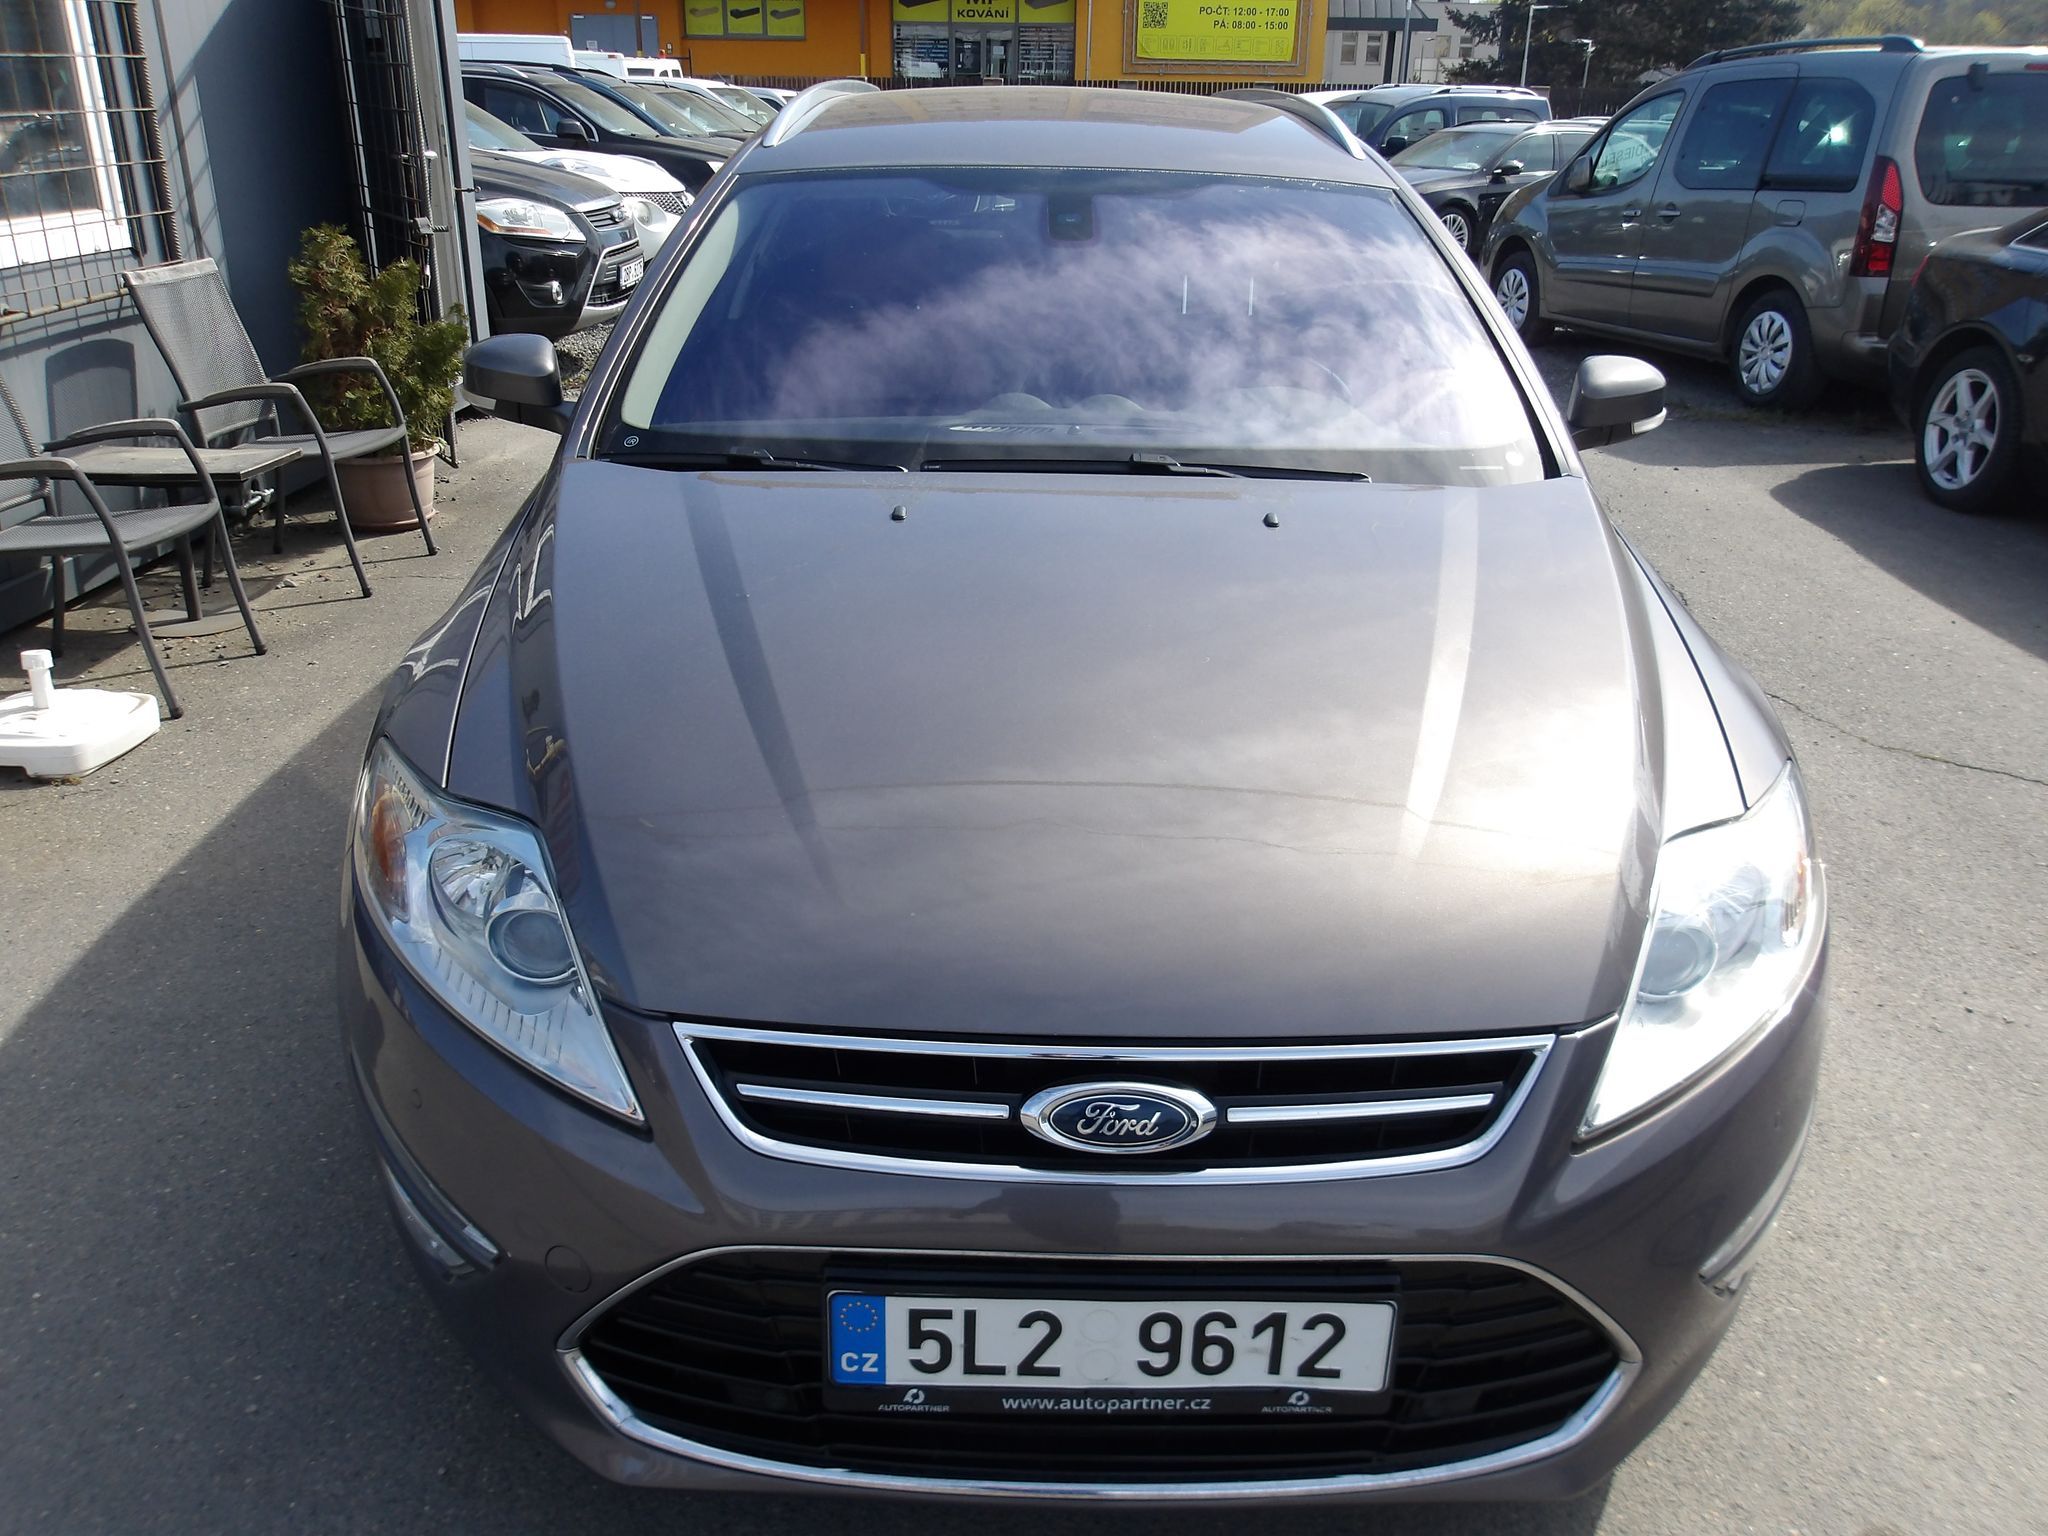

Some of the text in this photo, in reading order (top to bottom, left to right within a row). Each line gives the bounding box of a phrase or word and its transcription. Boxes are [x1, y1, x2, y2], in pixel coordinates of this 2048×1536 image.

[957, 7, 1009, 18] KOVÁNÍ
[1199, 5, 1230, 16] PO-ČT:
[1233, 7, 1257, 16] 12:00
[1265, 8, 1290, 17] 17:00
[1213, 18, 1229, 29] PÁ:
[1232, 20, 1256, 30] 08:00
[1264, 21, 1289, 30] 15:00
[1077, 1101, 1162, 1136] Ford
[907, 1308, 1347, 1379] 5L2 9612
[841, 1352, 879, 1372] CZ
[878, 1404, 950, 1413] AUTOPARTNER
[1002, 1394, 1212, 1413] www.autopartner.cz
[1261, 1405, 1333, 1414] AUTOPARTNER
